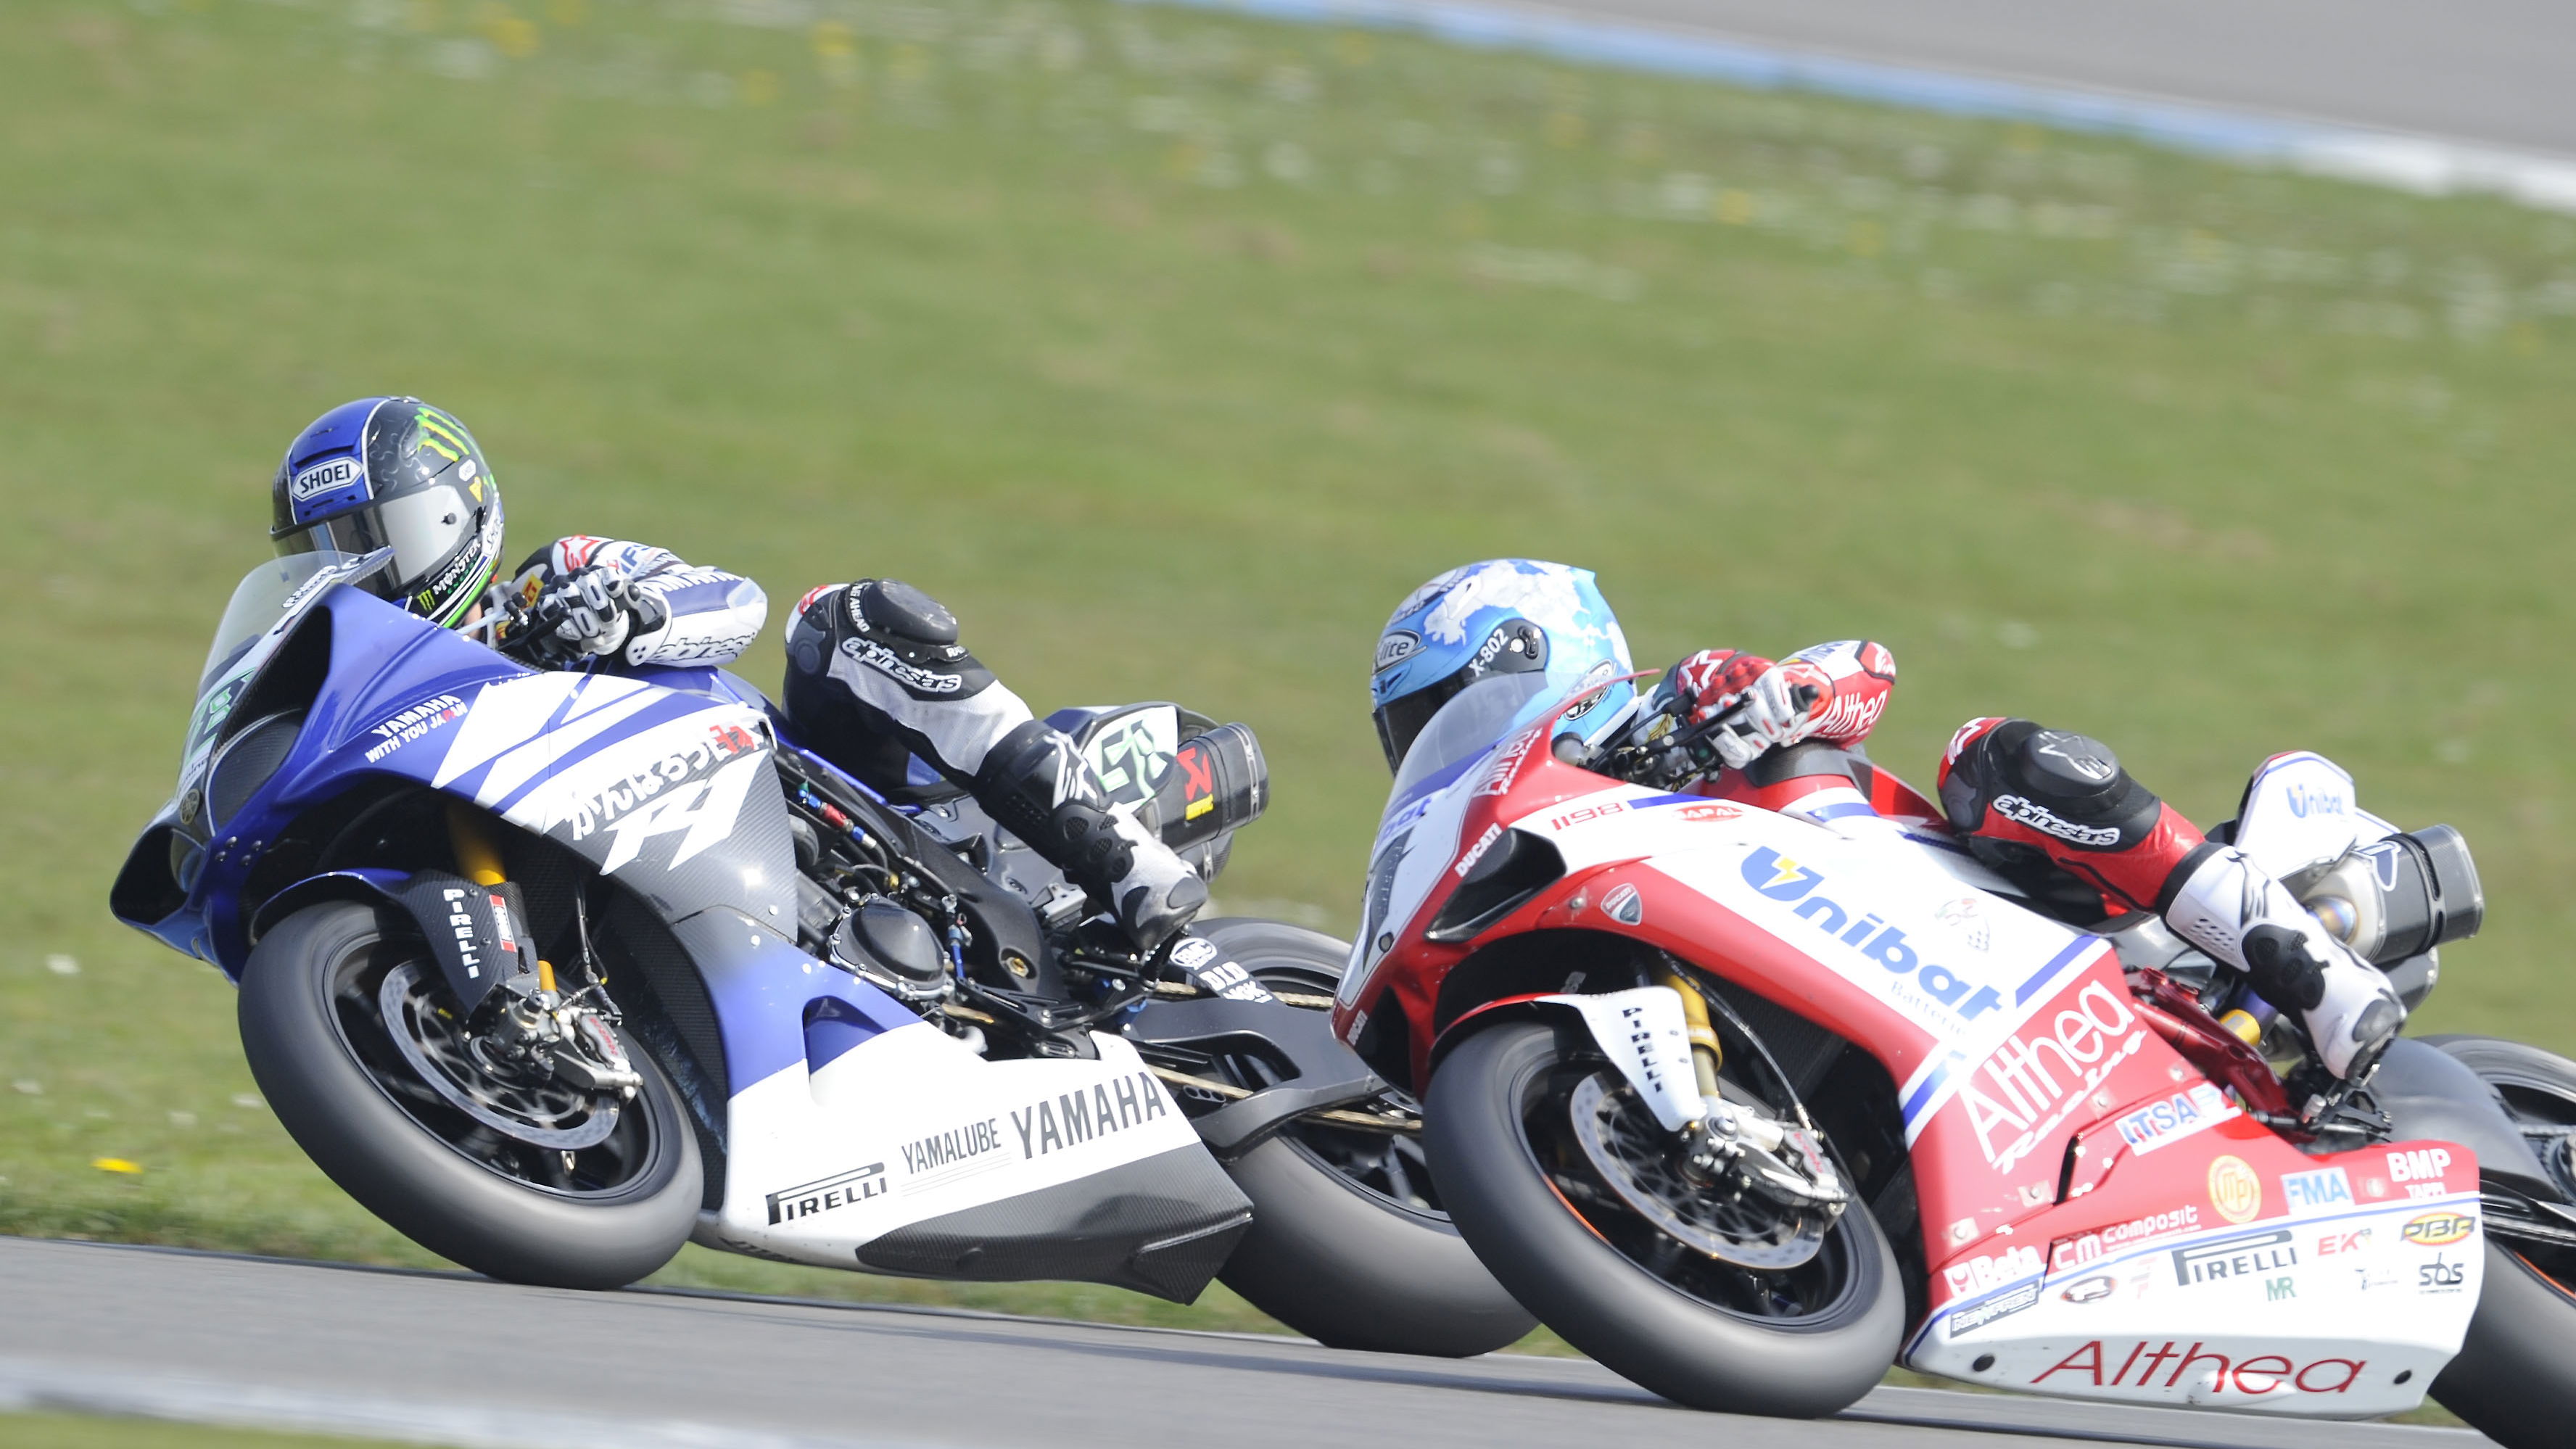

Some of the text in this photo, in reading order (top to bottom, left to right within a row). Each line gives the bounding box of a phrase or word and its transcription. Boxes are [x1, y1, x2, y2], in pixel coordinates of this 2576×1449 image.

[300, 463, 350, 494] SHOEI
[432, 539, 482, 595] MONSTER
[1468, 628, 1509, 677] X-802
[365, 701, 469, 763] WITH YOU JAPAN
[371, 694, 462, 738] YAMAHA
[1551, 802, 1624, 831] 1198
[1455, 822, 1503, 878] DUCATI
[442, 888, 481, 979] PIRELLI
[1741, 846, 2002, 1022] Unibat
[1622, 1006, 1663, 1094] PIRELLI
[1958, 979, 2136, 1163] Althea
[901, 1071, 1167, 1175] YAMALUBE YAMAHA
[2287, 1173, 2349, 1206] FMA
[2386, 1148, 2451, 1182] BMP
[765, 1162, 888, 1226] PIRELLI
[2171, 1230, 2298, 1287] PIRELLI
[2029, 1340, 2368, 1395] Althea
